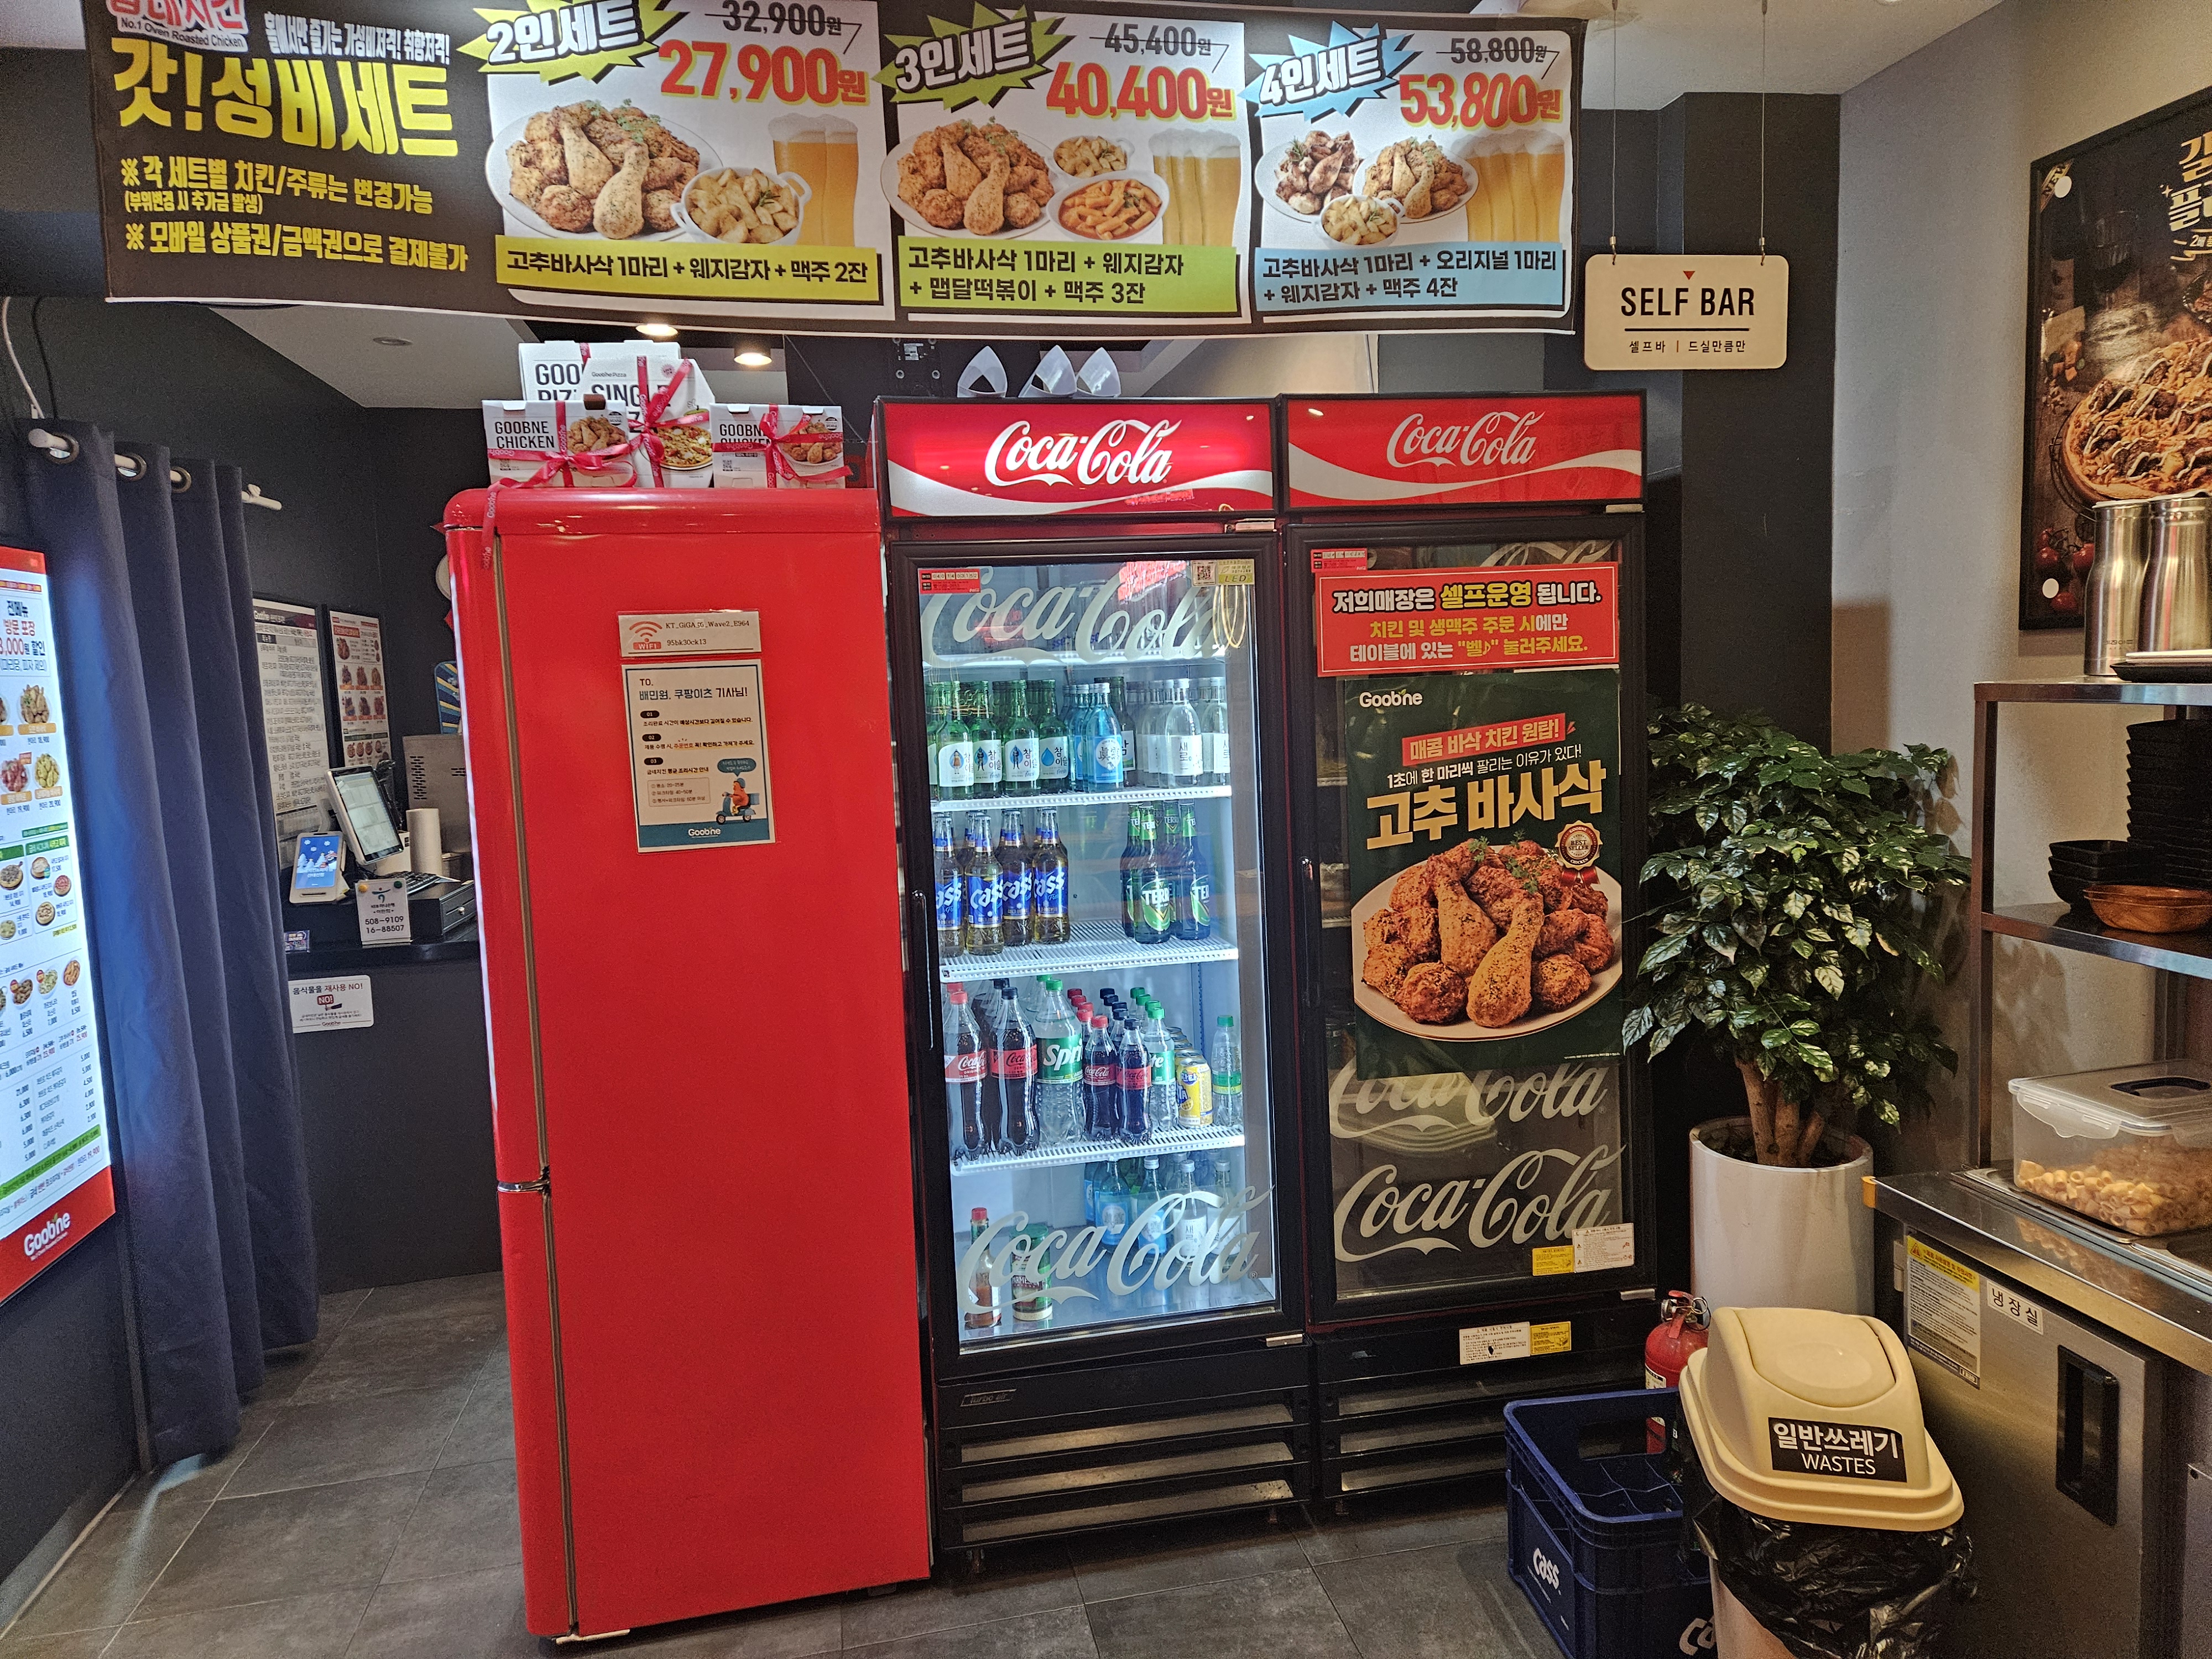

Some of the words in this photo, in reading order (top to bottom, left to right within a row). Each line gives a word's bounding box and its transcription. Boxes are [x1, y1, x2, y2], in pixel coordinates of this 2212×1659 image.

[121, 17, 141, 28] No.1
[144, 23, 169, 38] Oven
[171, 30, 210, 45] Roasted
[211, 34, 244, 48] Chicken
[486, 2, 637, 65] 2인세트
[722, 0, 842, 36] 32,900원
[264, 11, 309, 55] 홀에서만
[310, 18, 343, 56] 즐기는
[344, 23, 401, 61] 가성비저격!
[404, 28, 450, 65] 취향저격!
[1105, 22, 1212, 56] 45,400원
[1450, 36, 1548, 64] 58,800원
[658, 39, 868, 104] 27,900원
[895, 20, 1031, 93] 3인세트
[1259, 38, 1384, 106] 4인세트
[111, 37, 458, 156] 갓!성비세트
[1046, 61, 1236, 119] 40,400원
[1399, 72, 1564, 129] 53,800원
[142, 155, 163, 189] 각
[169, 156, 228, 192] 세트별
[234, 160, 348, 203] 치킨/주류는
[353, 178, 434, 215] 변경가능
[124, 190, 175, 215] (부위변경
[177, 192, 189, 212] 시
[192, 192, 230, 213] 추가금
[232, 192, 263, 215] 발생)
[149, 221, 207, 254] 모바일
[210, 222, 384, 264] 상품권/금액권으로
[388, 236, 469, 272] 결제불가
[909, 246, 1017, 272] 고추바사삭
[1024, 249, 1077, 273] 1마리
[1102, 251, 1184, 276] 웨지감자
[507, 249, 613, 277] 고추바사삭
[617, 254, 667, 279] 1마리
[689, 257, 771, 281] 웨지감자
[790, 259, 830, 283] 맥주
[834, 261, 868, 284] 2잔
[1262, 254, 1358, 279] 고추바사삭
[1363, 251, 1413, 274] 1마리
[1436, 249, 1510, 271] 오리지널
[1513, 249, 1557, 271] 1마리
[930, 278, 1037, 302] 맵달떡볶이
[1063, 280, 1104, 304] 맥주
[1111, 282, 1146, 304] 3잔
[1281, 280, 1360, 304] 웨지감자
[1383, 279, 1421, 299] 맥주
[1426, 277, 1458, 298] 4잔
[1621, 286, 1689, 317] SELF
[1700, 287, 1755, 316] BAR
[1629, 340, 1666, 354] 셀프바
[1688, 340, 1746, 353] 드실만큼만
[535, 363, 581, 385] GOO
[495, 421, 549, 435] GOOBNE
[496, 436, 555, 449] CHICKEN
[1386, 410, 1546, 468] Coca-Cola
[985, 419, 1183, 487] Coca-Cola
[1332, 591, 1435, 614] 저희매장은
[1439, 582, 1532, 609] 셀프운영
[1537, 582, 1602, 606] 됩니다.
[1369, 620, 1404, 638] 치킨
[1408, 619, 1425, 637] 및
[1429, 618, 1479, 636] 생맥주
[1482, 616, 1515, 634] 주문
[1519, 613, 1568, 633] 시에만
[1349, 643, 1416, 662] 테이블에
[1420, 642, 1453, 659] 있는
[1503, 635, 1588, 655] 눌러주세요.
[639, 678, 654, 686] TO.
[674, 688, 713, 700] 쿠팡이츠
[716, 687, 748, 698] 기사님!
[1359, 689, 1423, 708] Goobne
[1410, 736, 1444, 761] 매콤
[1447, 731, 1482, 753] 바삭
[1485, 724, 1518, 748] 치킨
[1521, 718, 1561, 743] 원탑!
[1386, 769, 1418, 789] 1초에
[1421, 768, 1434, 784] 한
[1436, 764, 1474, 781] 마리씩
[1477, 757, 1514, 774] 팔리는
[1516, 749, 1552, 768] 이유가
[1554, 743, 1582, 763] 있다!
[1366, 786, 1458, 850] 고추
[1468, 759, 1606, 832] 바사삭
[688, 827, 721, 837] Goobne
[365, 916, 404, 925] 508-9109
[366, 925, 404, 934] 16-88507
[318, 996, 333, 1004] NO!
[324, 984, 347, 993] 재사용
[1043, 1041, 1083, 1071] Spri
[1334, 1144, 1627, 1263] Coca-Cola
[24, 1212, 71, 1256] Goobne
[957, 1184, 1276, 1314] Coca-Cola
[1992, 1288, 2038, 1327] 냉장실
[1773, 1422, 1899, 1459] 일반쓰레기
[1801, 1452, 1877, 1475] WASTES
